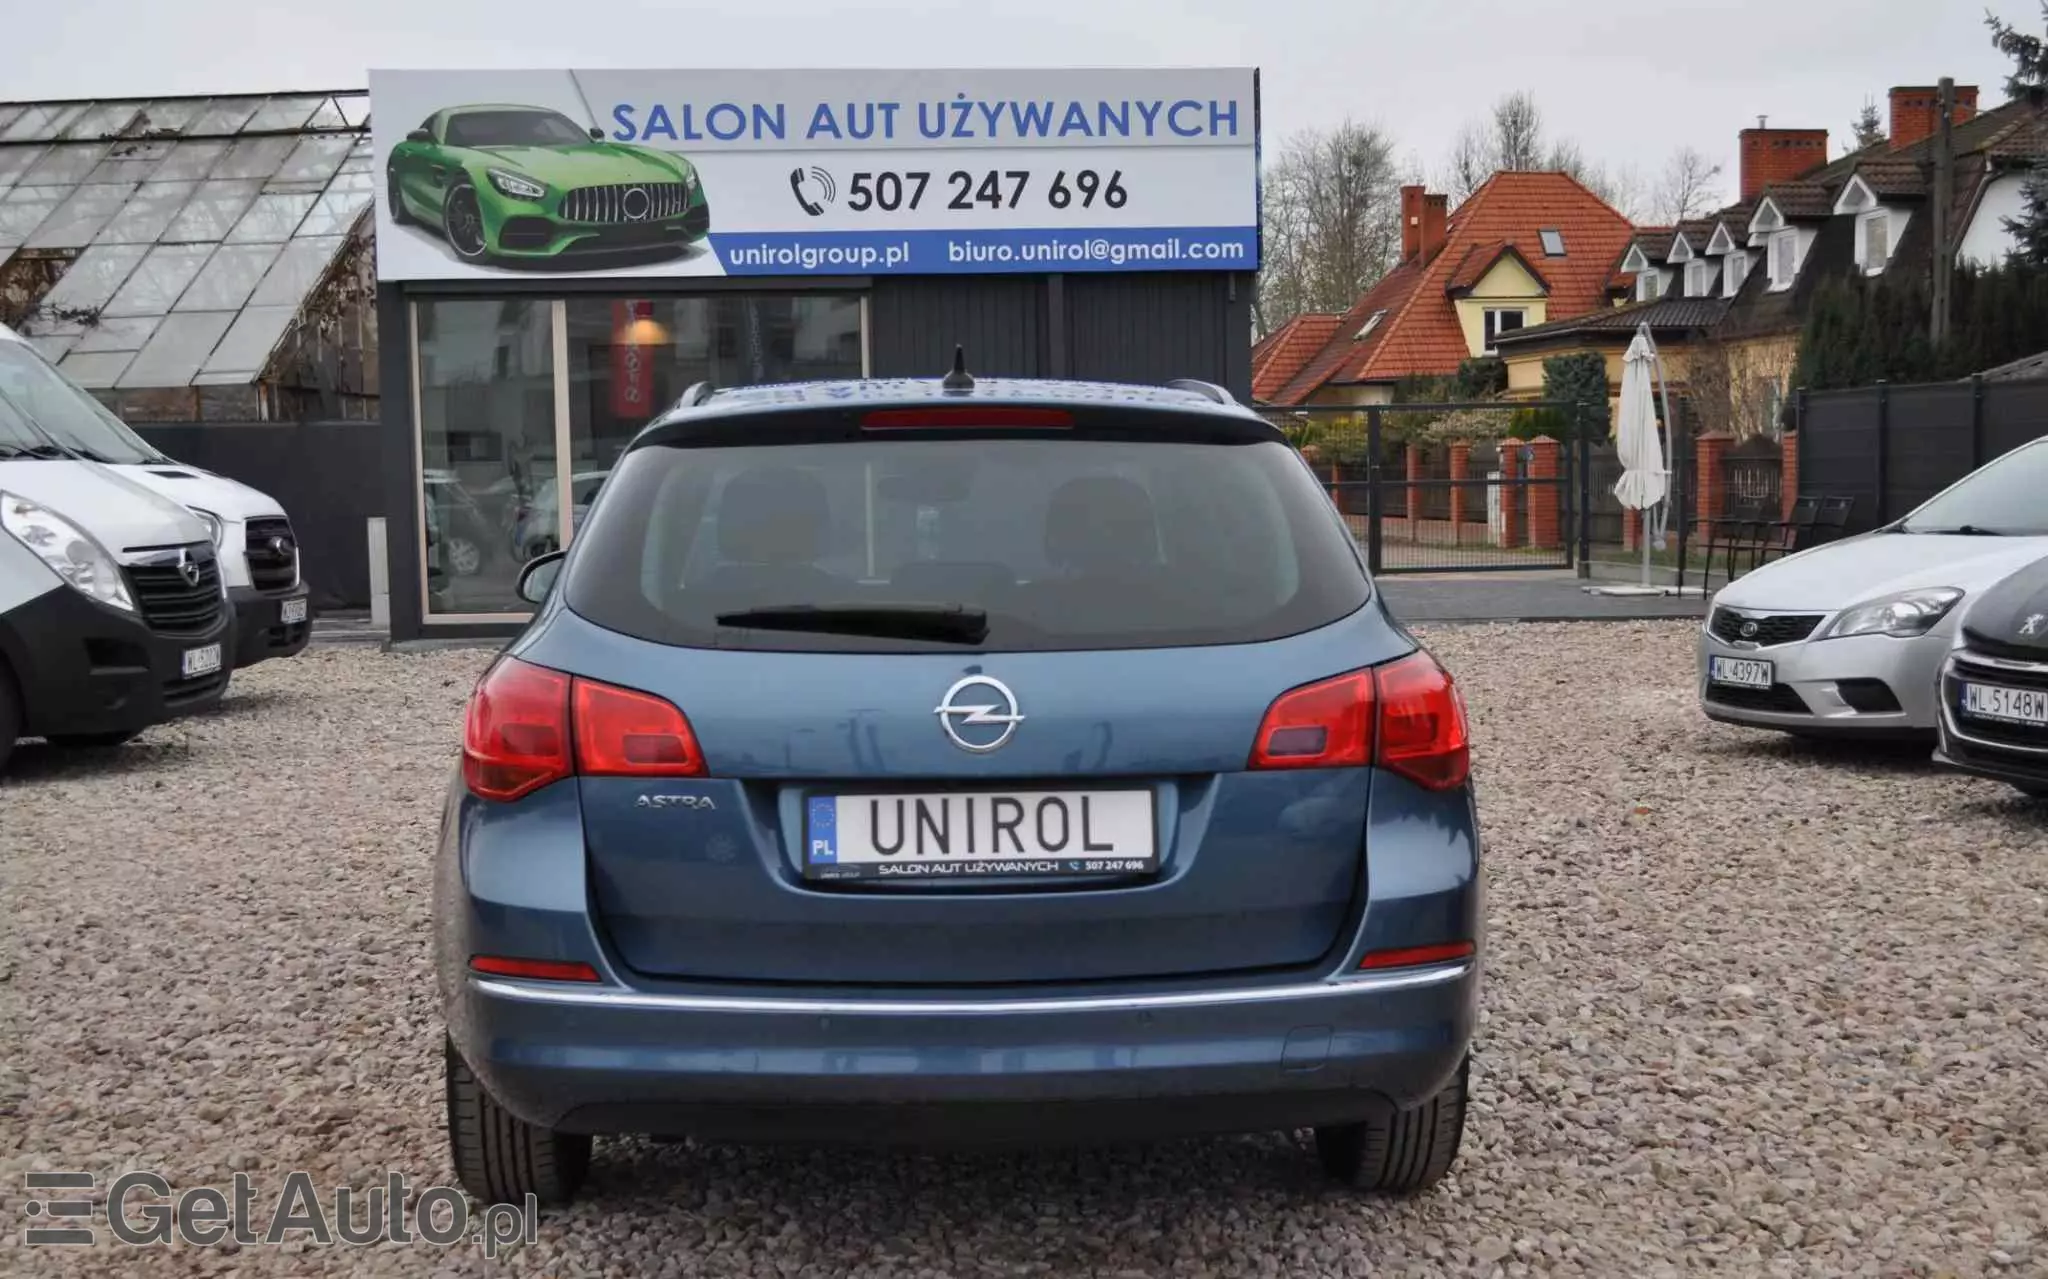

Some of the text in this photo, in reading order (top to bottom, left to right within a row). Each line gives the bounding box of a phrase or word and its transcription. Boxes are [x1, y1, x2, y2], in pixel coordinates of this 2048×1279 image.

[612, 92, 1238, 141] SALON AUT UŻYWANYCH
[847, 169, 1128, 211] 507 247 696
[729, 238, 1244, 269] unirolgroup.pl biuro.unirol@gmail.com
[634, 794, 717, 810] ASTRA
[870, 795, 1114, 856] UNIROL
[813, 840, 834, 856] PL
[878, 860, 1144, 875] SALON AUT UŻYWANYCH 507 247 696
